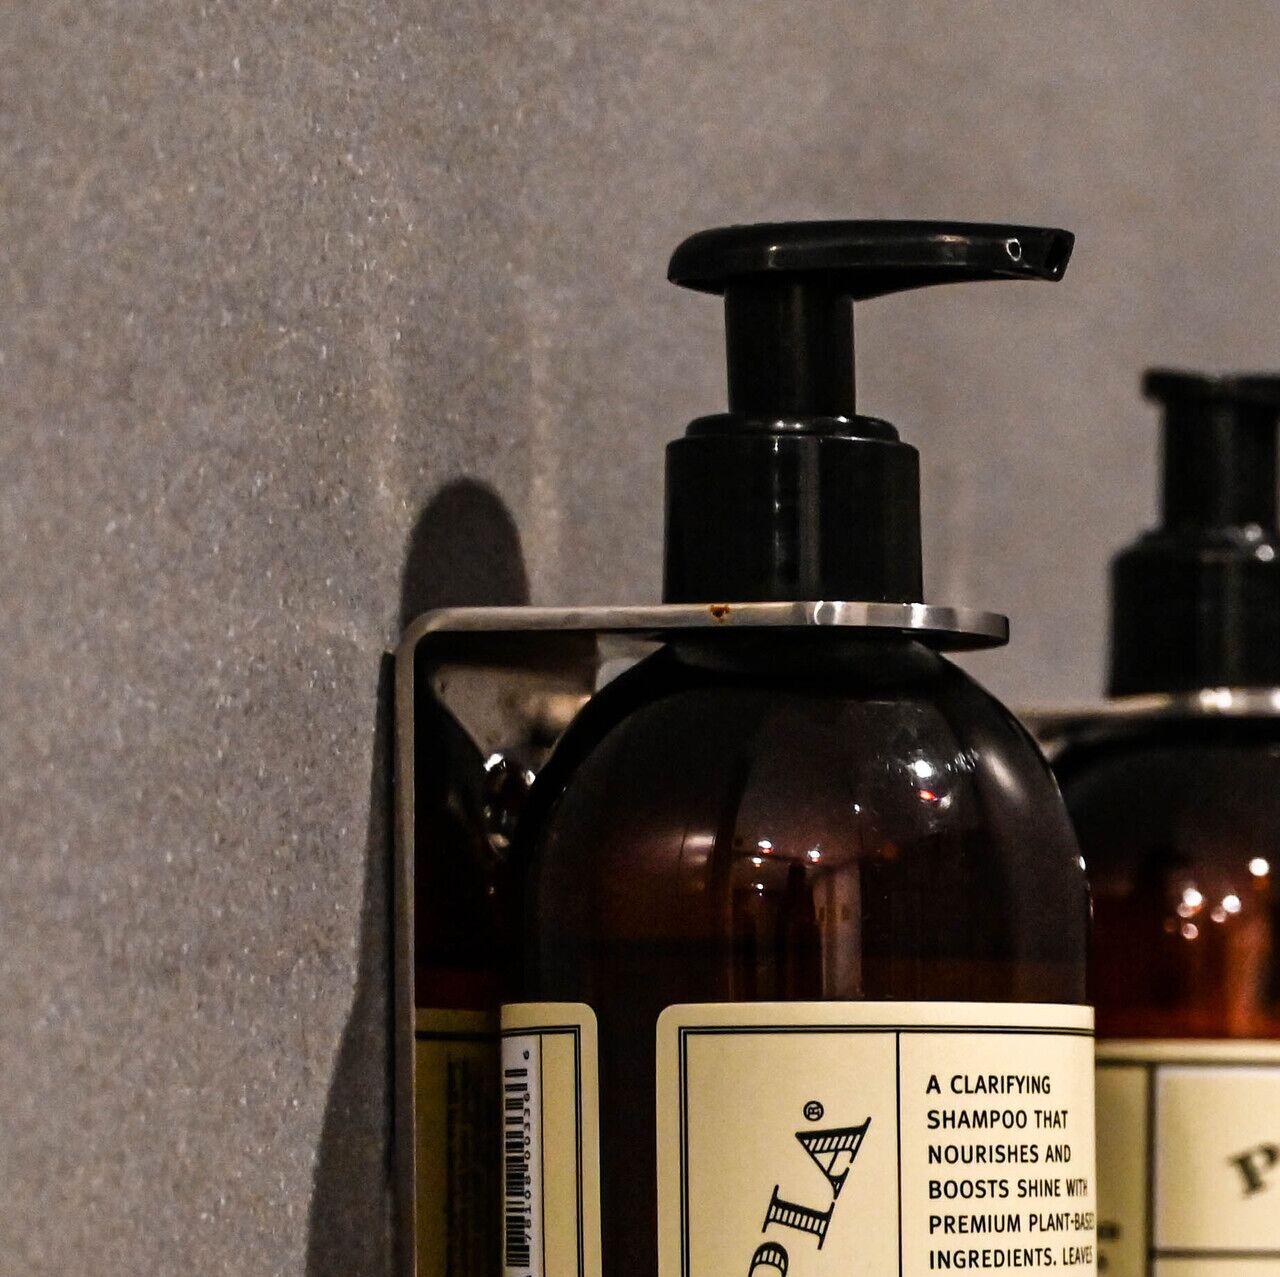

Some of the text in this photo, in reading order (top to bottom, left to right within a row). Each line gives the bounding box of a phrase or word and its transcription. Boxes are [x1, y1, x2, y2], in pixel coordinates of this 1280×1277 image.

[926, 1075, 1051, 1094] A CLARIFYING
[927, 1110, 1068, 1129] SHAMPOO THAT
[928, 1144, 1071, 1164] NOURISHES AND
[929, 1178, 1088, 1199] BOOSTS SHINE WITH
[929, 1214, 1021, 1234] PREMIUM
[930, 1248, 1057, 1270] INGREDIENTS.
